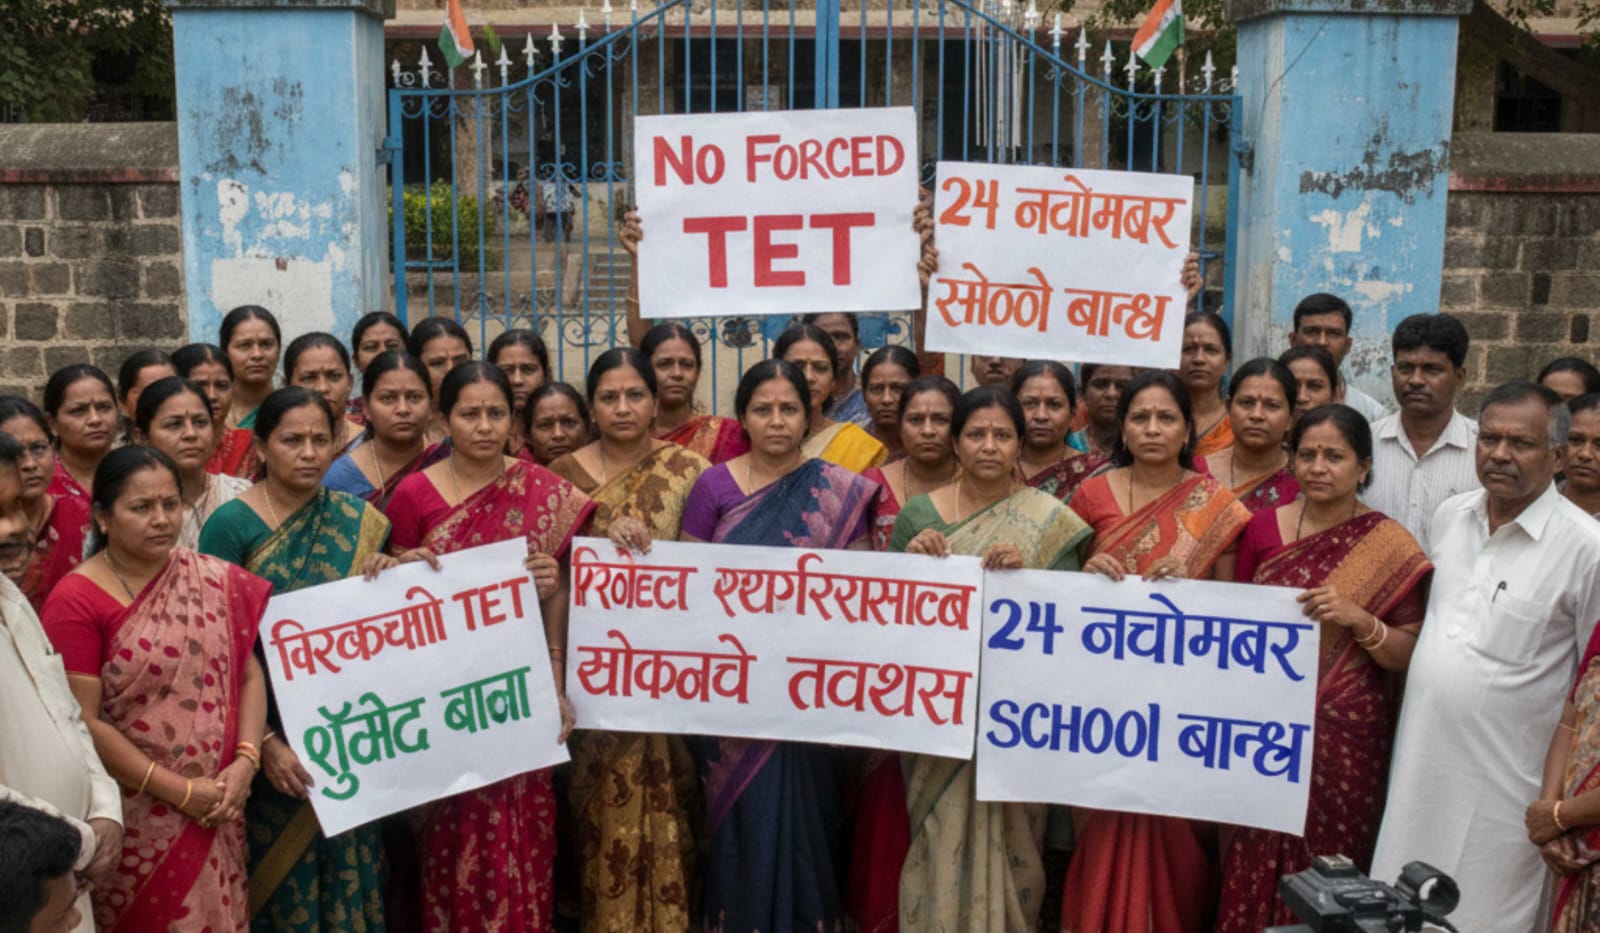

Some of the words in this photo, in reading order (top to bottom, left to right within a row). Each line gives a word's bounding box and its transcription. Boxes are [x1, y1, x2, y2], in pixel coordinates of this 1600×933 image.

[746, 135, 905, 183] FORCED
[939, 177, 999, 229] 24
[683, 212, 875, 288] TET
[452, 576, 529, 631] TET
[987, 598, 1064, 655] 24
